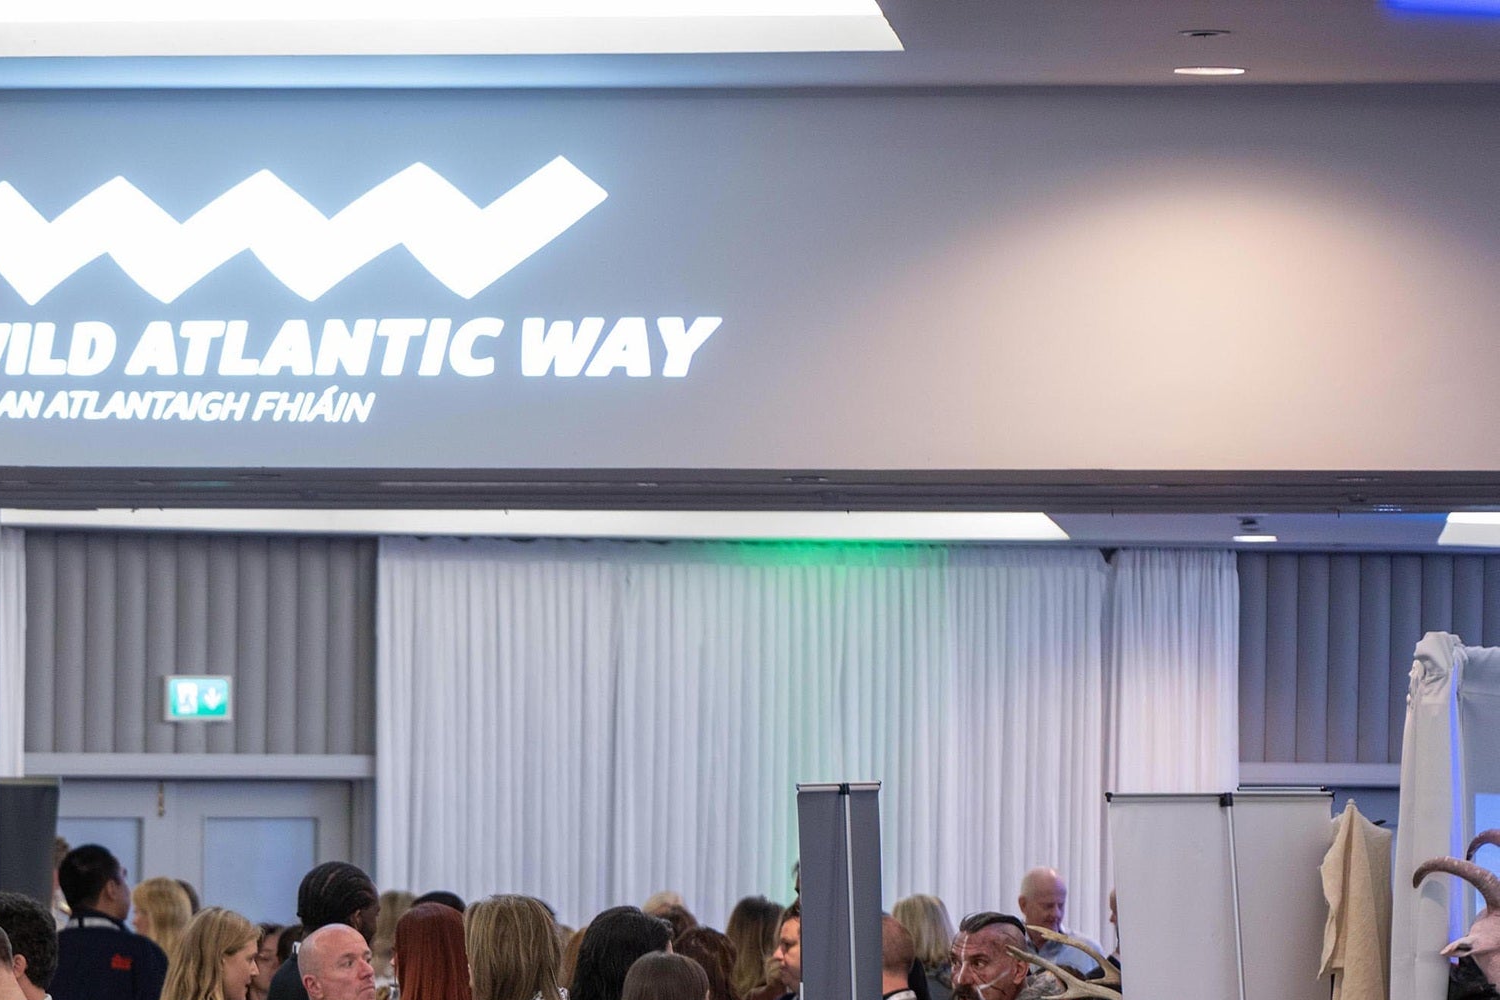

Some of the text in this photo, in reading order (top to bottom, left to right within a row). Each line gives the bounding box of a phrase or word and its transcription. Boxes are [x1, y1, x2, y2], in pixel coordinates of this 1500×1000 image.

[124, 318, 504, 376] ATLANTIC
[521, 317, 722, 376] WAY
[43, 390, 249, 421] ATLANTAIGH
[251, 385, 375, 422] FHIÁIN
